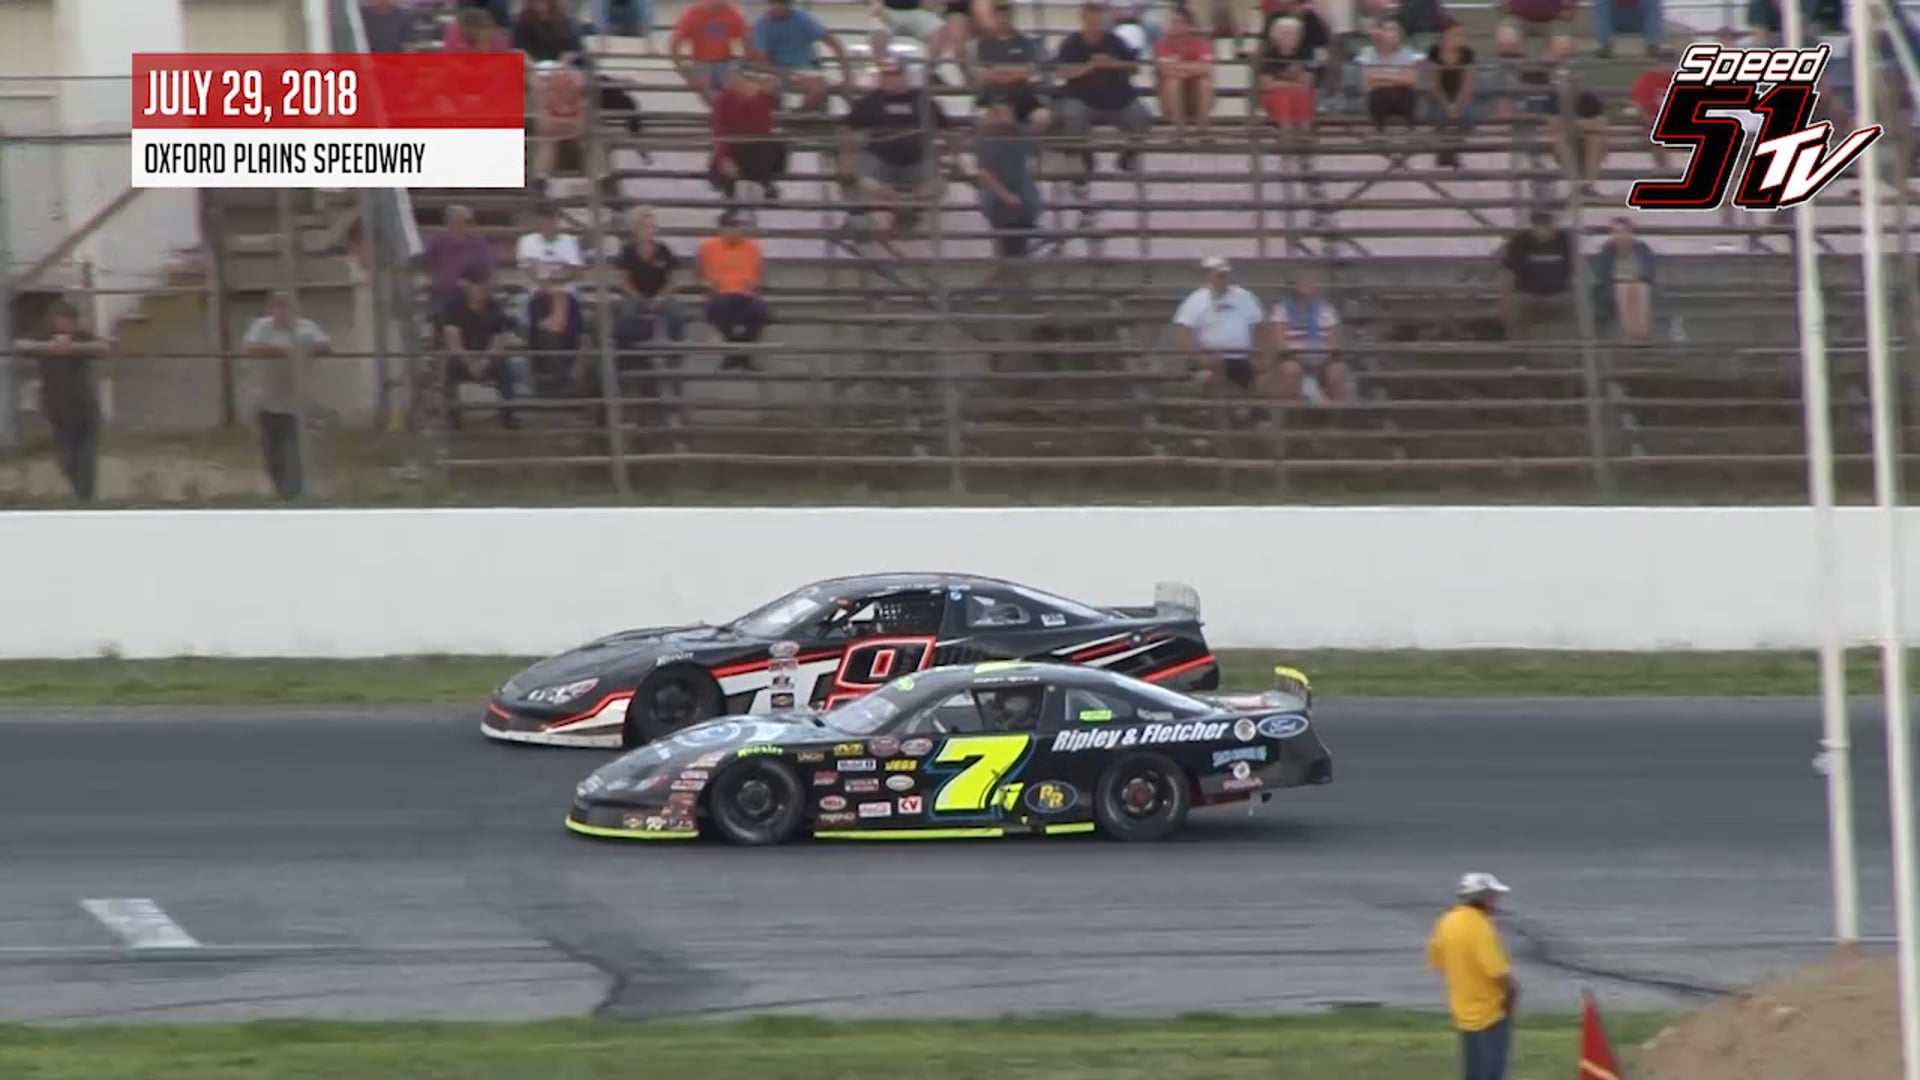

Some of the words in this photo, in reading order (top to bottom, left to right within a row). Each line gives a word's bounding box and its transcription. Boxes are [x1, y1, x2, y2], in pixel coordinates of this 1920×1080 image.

[1052, 729, 1122, 752] Ripley
[1121, 728, 1138, 745] &
[1140, 721, 1231, 744] Fletcher
[934, 735, 1030, 810] 7
[900, 799, 919, 811] CV
